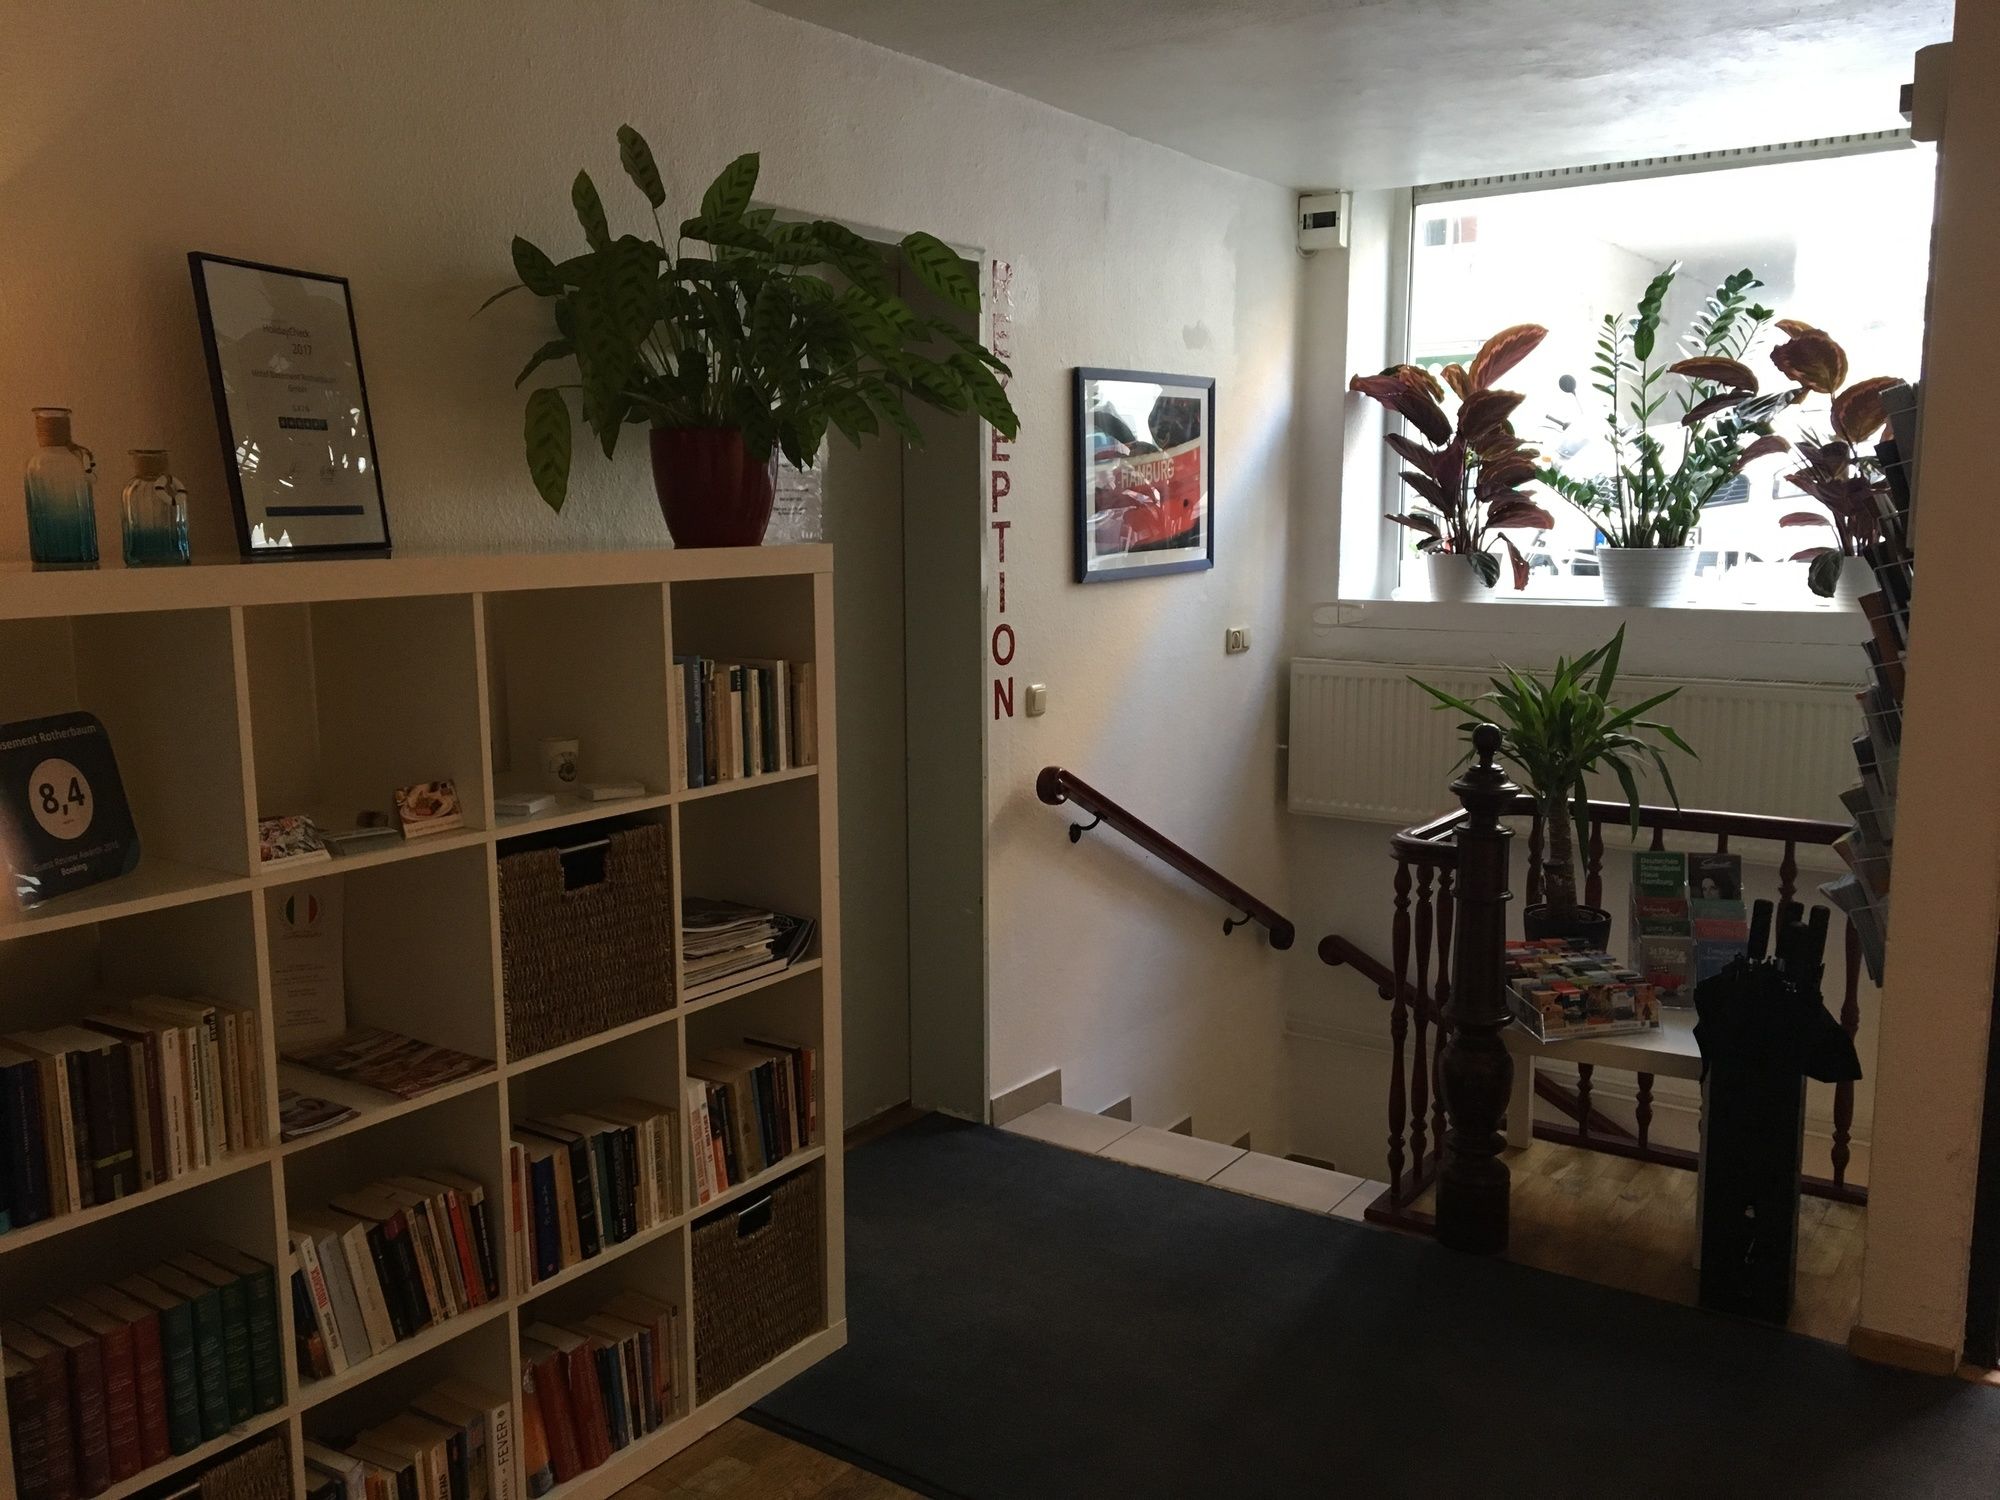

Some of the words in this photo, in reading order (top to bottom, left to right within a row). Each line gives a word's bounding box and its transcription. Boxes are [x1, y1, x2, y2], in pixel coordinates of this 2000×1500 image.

[292, 343, 312, 355] 2017
[991, 259, 1015, 720] REEPTION
[1121, 457, 1174, 489] HAMBURG
[0, 735, 38, 751] sement
[38, 724, 97, 742] Rotherbaum
[39, 777, 85, 816] 8,4
[496, 1418, 509, 1466] FEVER
